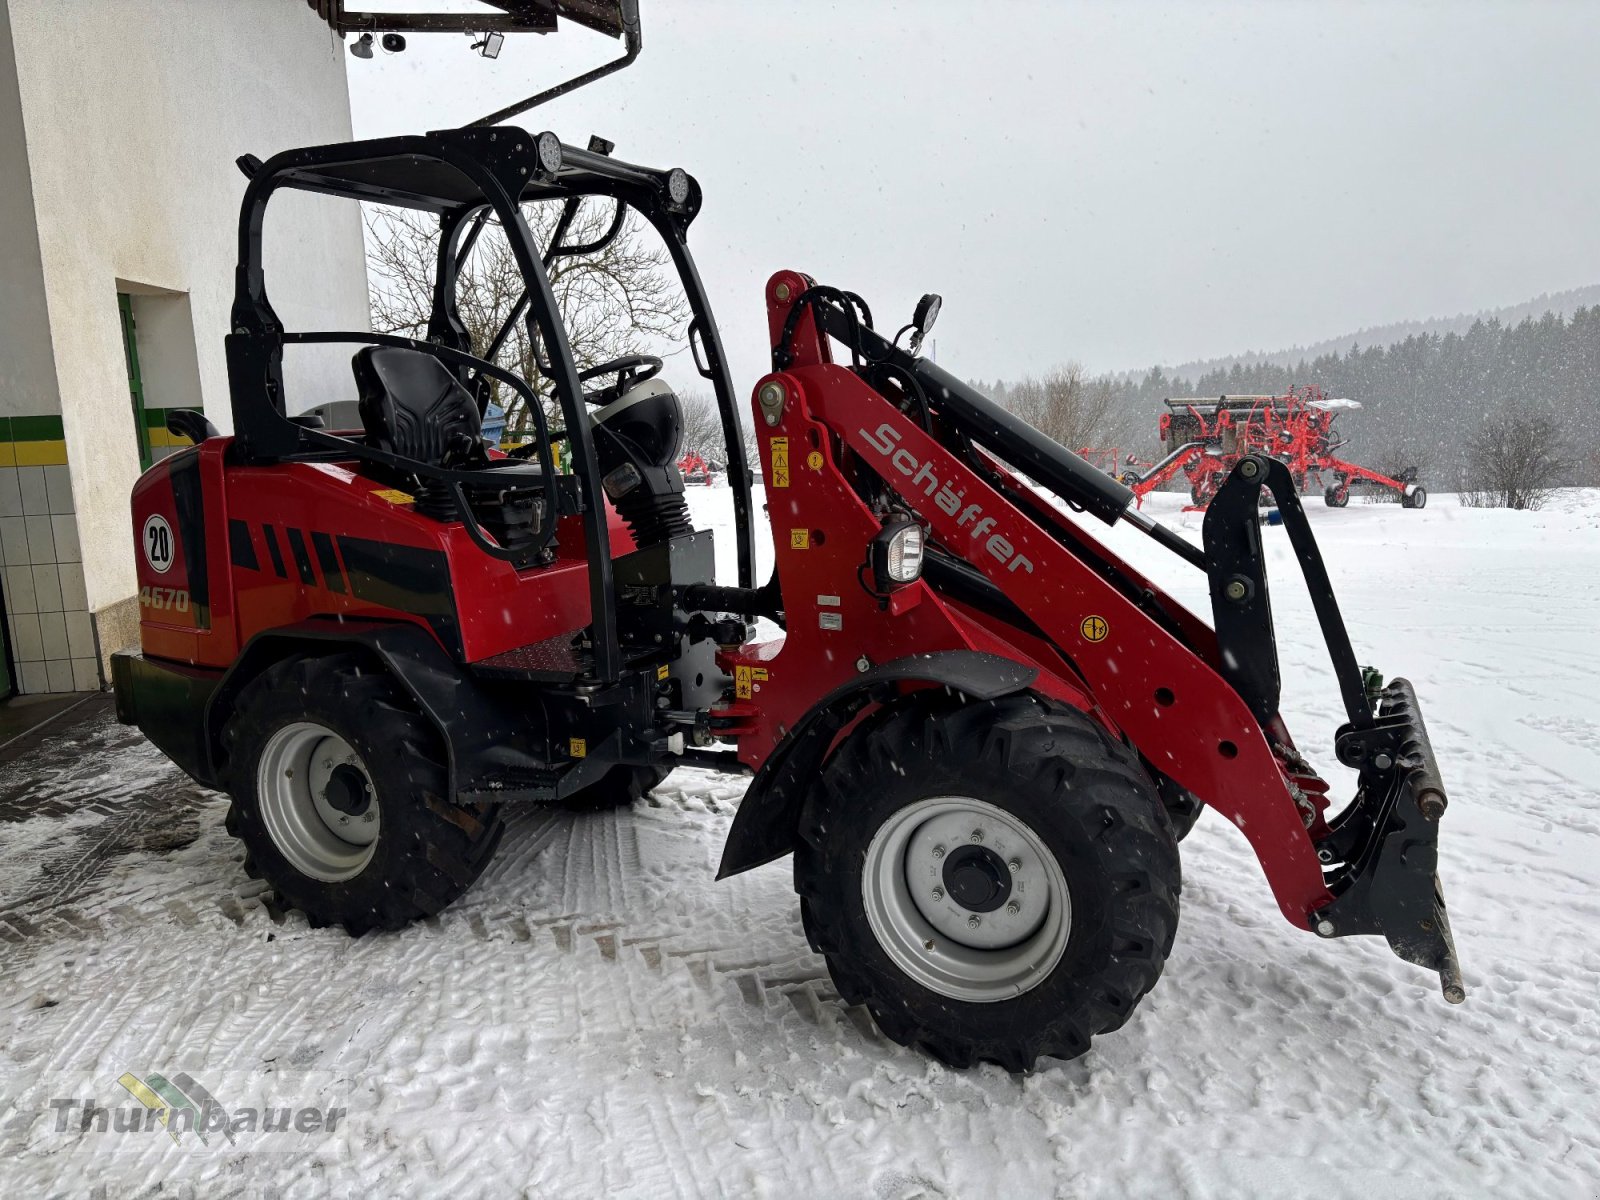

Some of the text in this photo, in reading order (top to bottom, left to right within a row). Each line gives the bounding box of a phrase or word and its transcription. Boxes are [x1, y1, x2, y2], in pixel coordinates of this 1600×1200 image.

[858, 423, 1034, 574] Schäffer
[149, 526, 169, 562] 20
[140, 585, 189, 613] 4670
